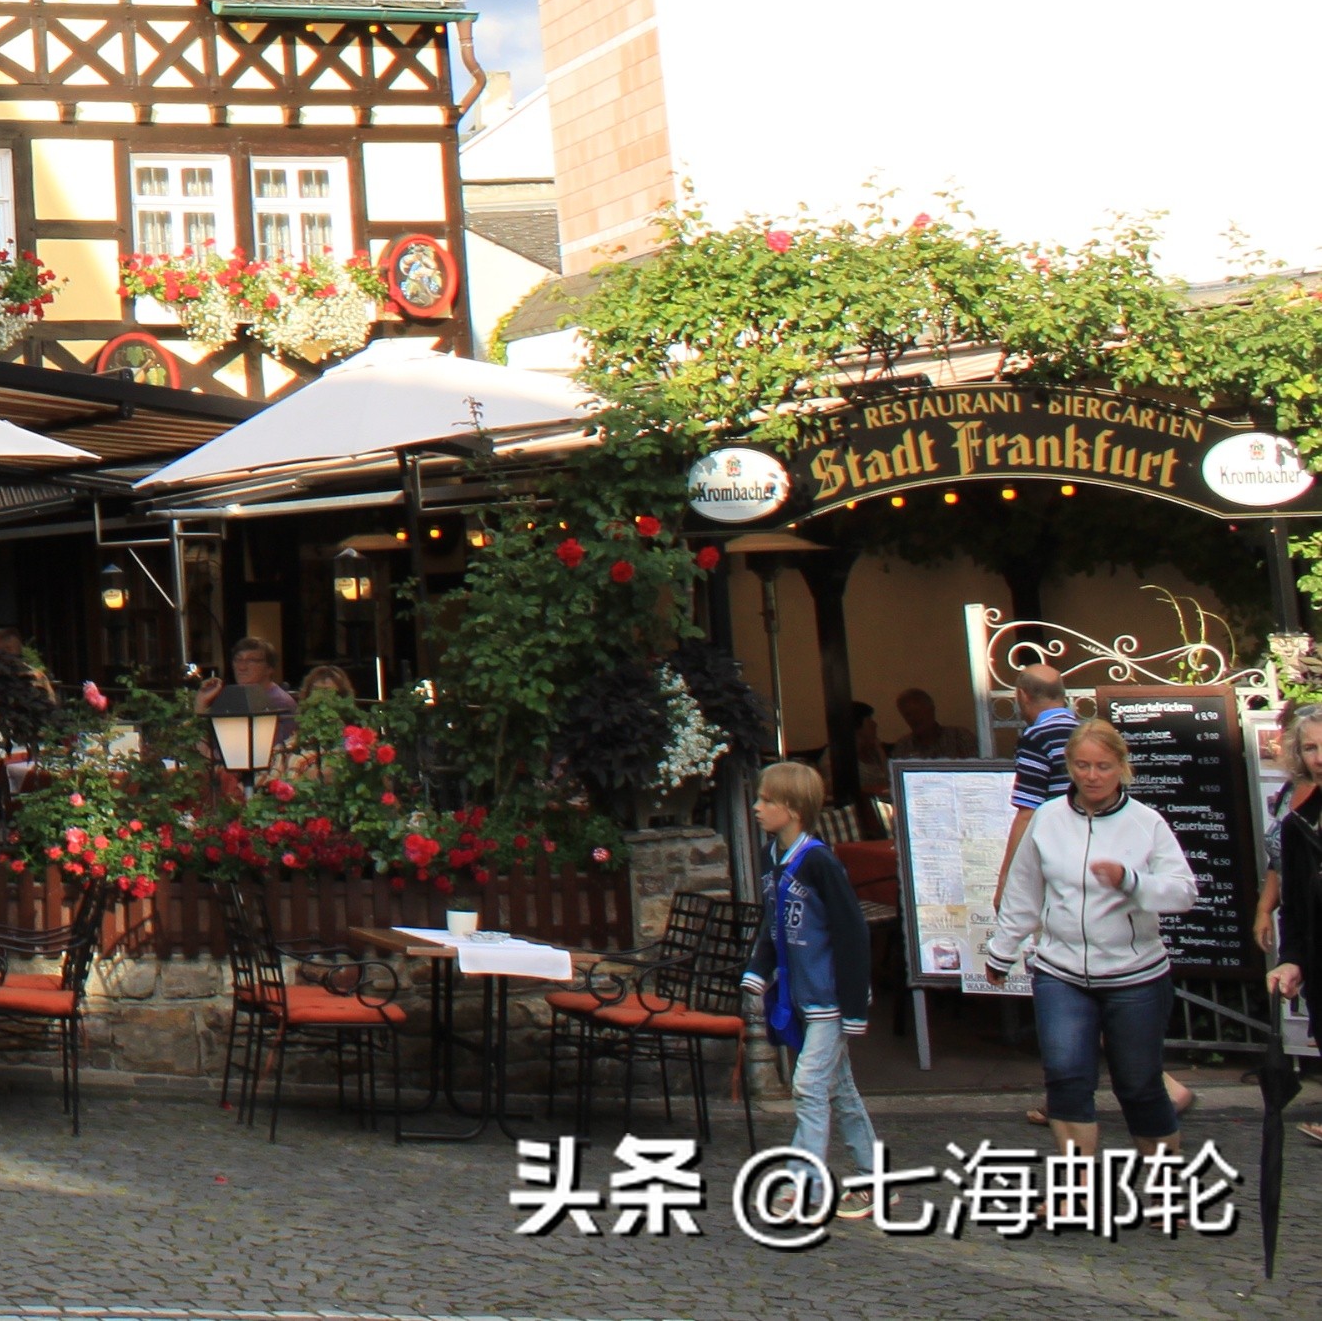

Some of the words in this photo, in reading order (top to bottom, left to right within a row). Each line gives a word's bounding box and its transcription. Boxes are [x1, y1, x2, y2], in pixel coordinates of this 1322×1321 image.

[863, 391, 1023, 429] RESTAURANT
[1048, 394, 1204, 443] BIERGARTEN
[809, 428, 941, 501] Stadt
[947, 419, 1180, 489] Frankfurt
[1220, 465, 1302, 485] Krombacher
